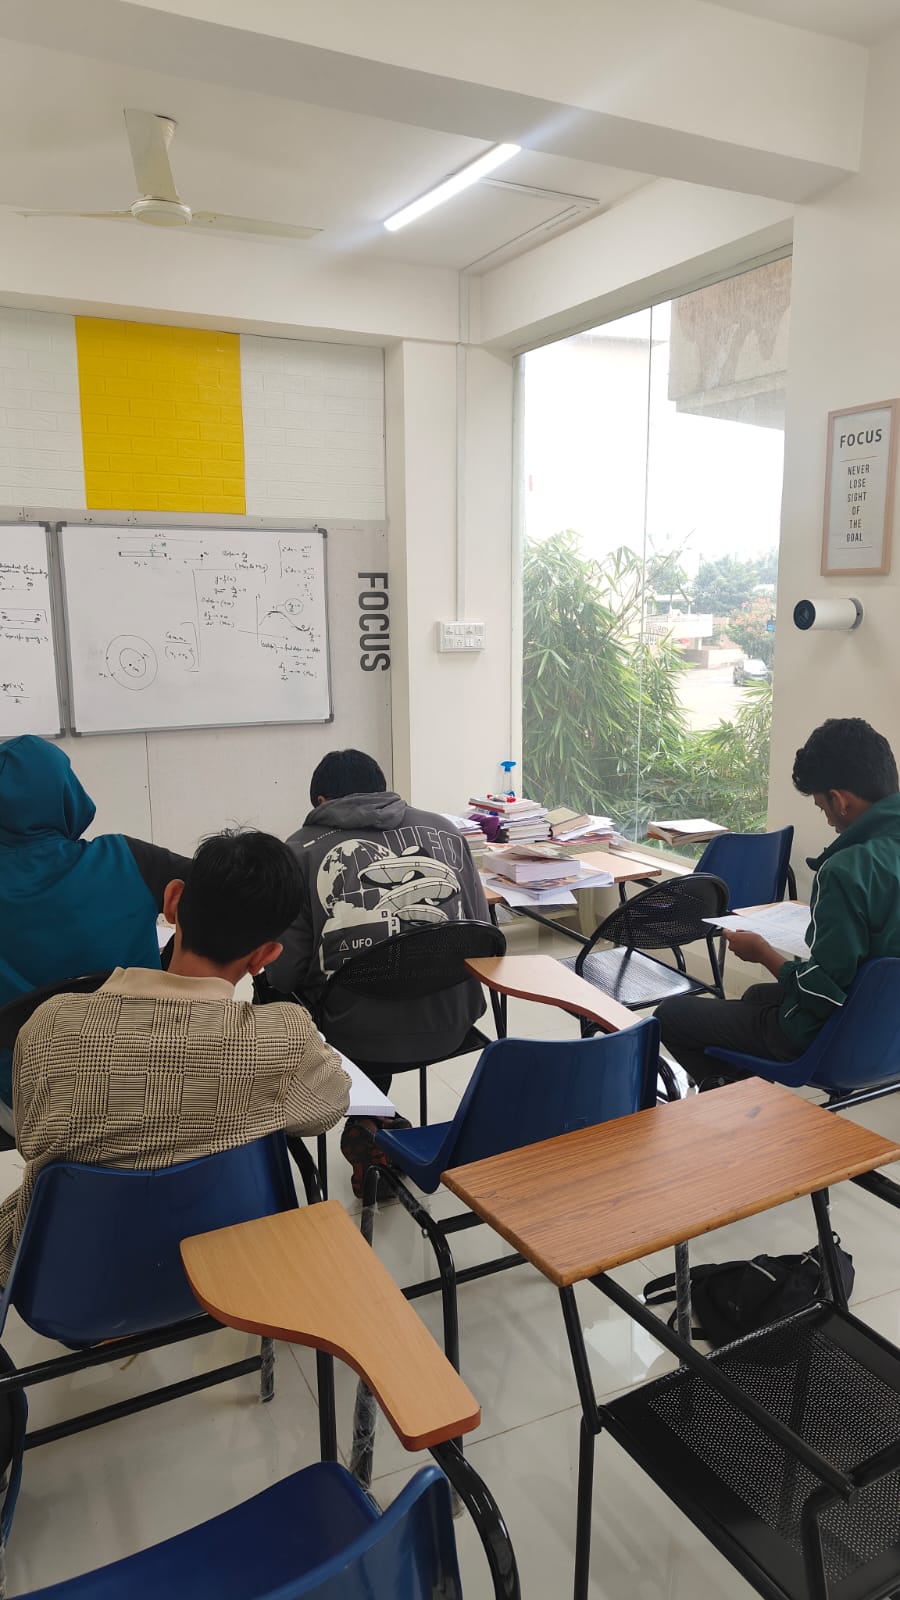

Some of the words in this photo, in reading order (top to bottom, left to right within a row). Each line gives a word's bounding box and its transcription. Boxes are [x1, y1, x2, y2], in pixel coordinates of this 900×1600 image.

[839, 428, 883, 448] FOCUS
[847, 463, 870, 476] NEVER
[849, 478, 866, 489] LOSE
[847, 491, 867, 503] SIGHT
[851, 505, 861, 515] OF
[849, 518, 862, 529] THE
[846, 532, 863, 543] GOAL
[358, 572, 391, 672] FOCUS
[352, 937, 373, 950] UFO
